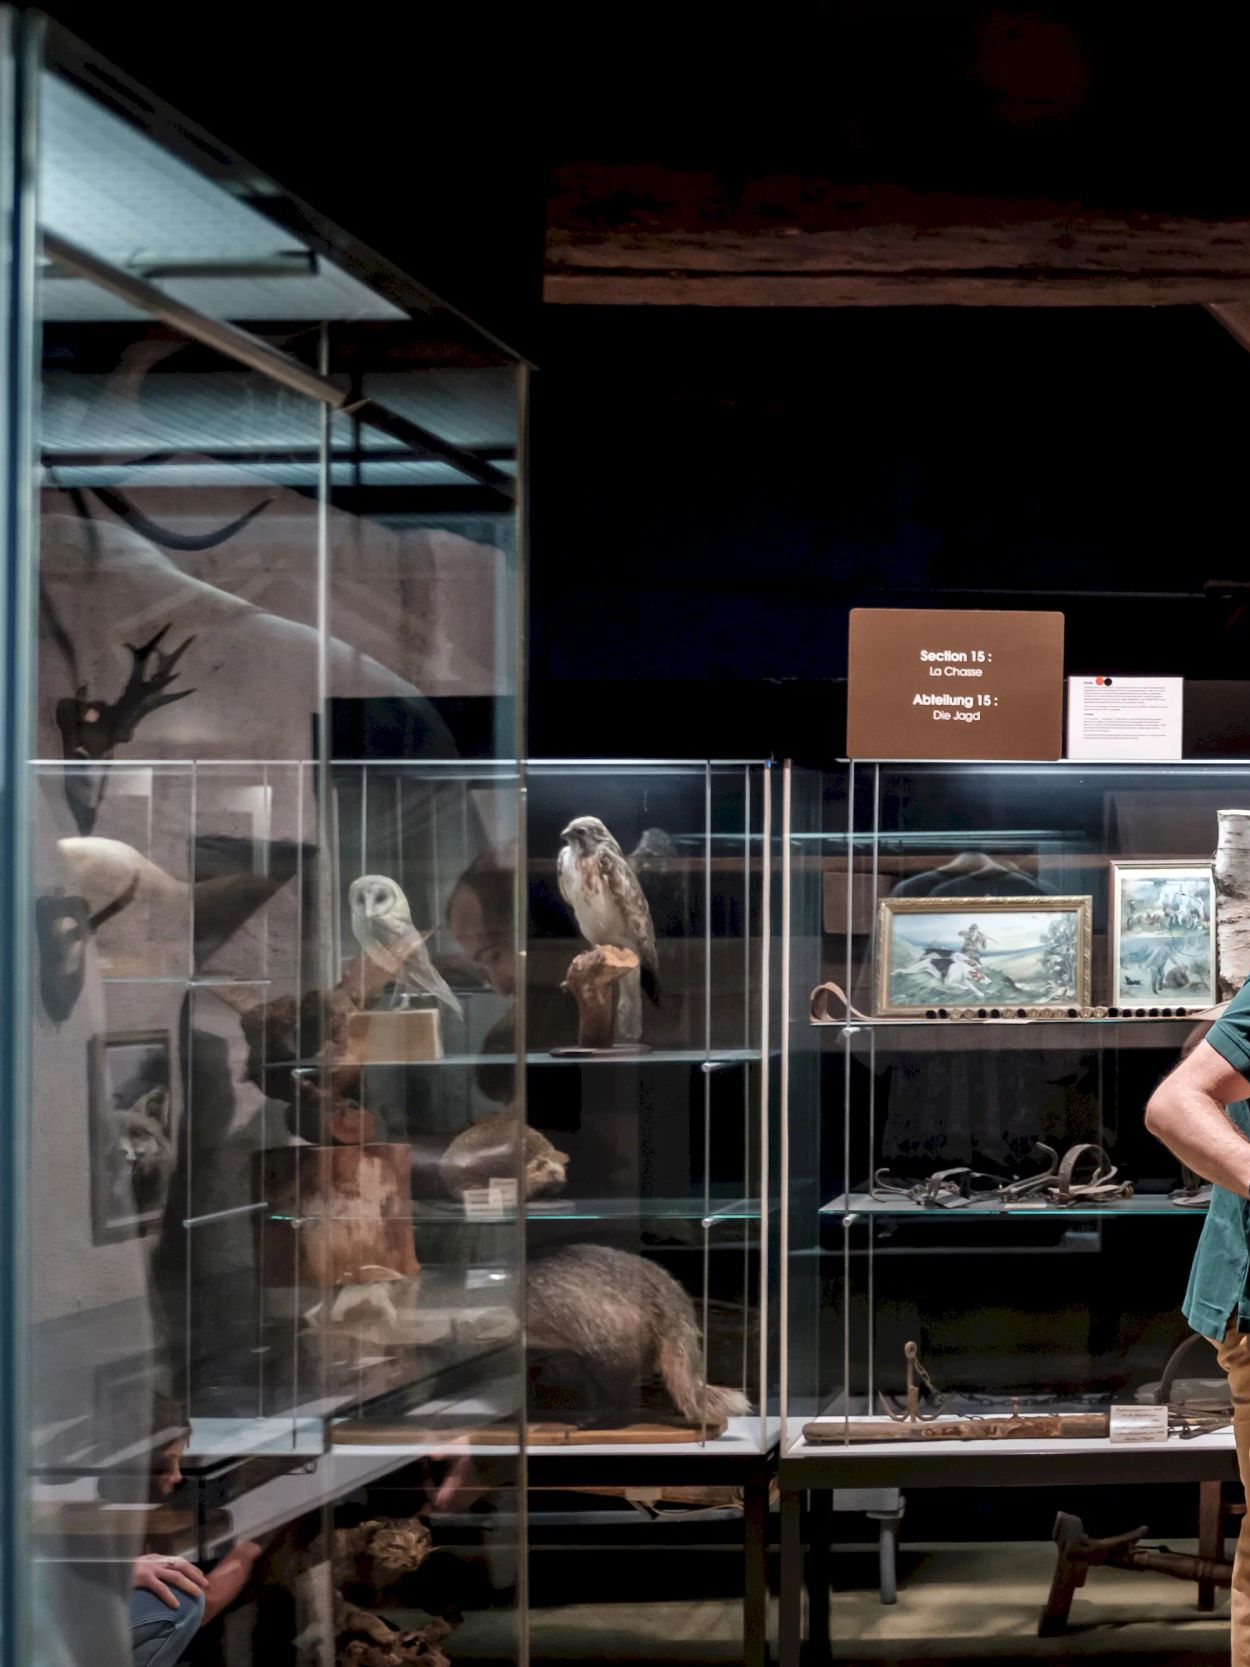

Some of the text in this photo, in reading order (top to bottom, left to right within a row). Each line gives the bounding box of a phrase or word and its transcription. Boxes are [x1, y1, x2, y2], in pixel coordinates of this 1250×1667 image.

[919, 650, 968, 662] Section
[929, 666, 984, 677] La Chasse
[912, 694, 974, 708] Abteilung
[932, 710, 981, 723] Die Jagd
